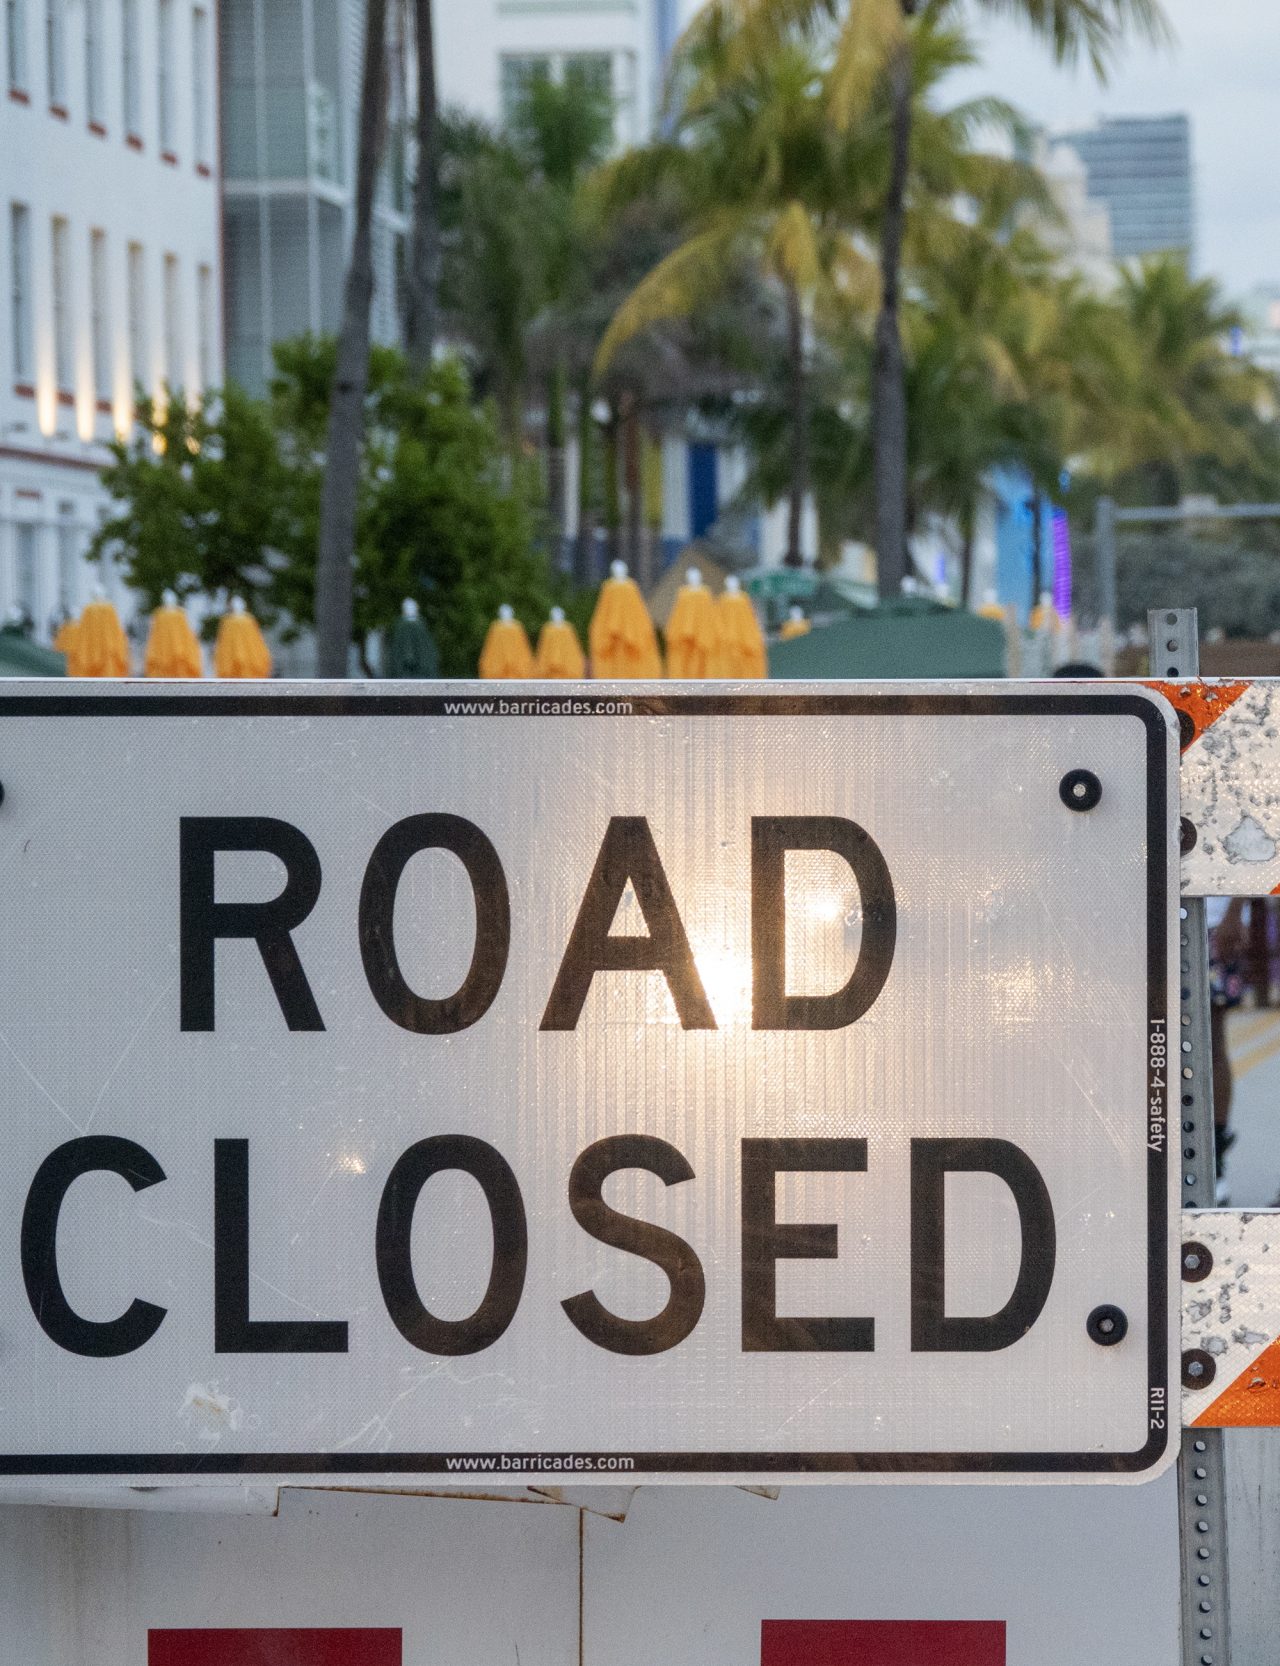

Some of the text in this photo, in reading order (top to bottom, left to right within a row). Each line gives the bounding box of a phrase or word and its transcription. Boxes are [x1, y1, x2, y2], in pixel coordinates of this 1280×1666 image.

[444, 699, 633, 714] www.barricades.com
[179, 812, 897, 1036] ROAD
[1147, 1018, 1166, 1152] 1-888-4-safety
[20, 1134, 1057, 1358] CLOSED
[1150, 1387, 1165, 1429] R11-2
[446, 1454, 635, 1470] www.barricades.com
